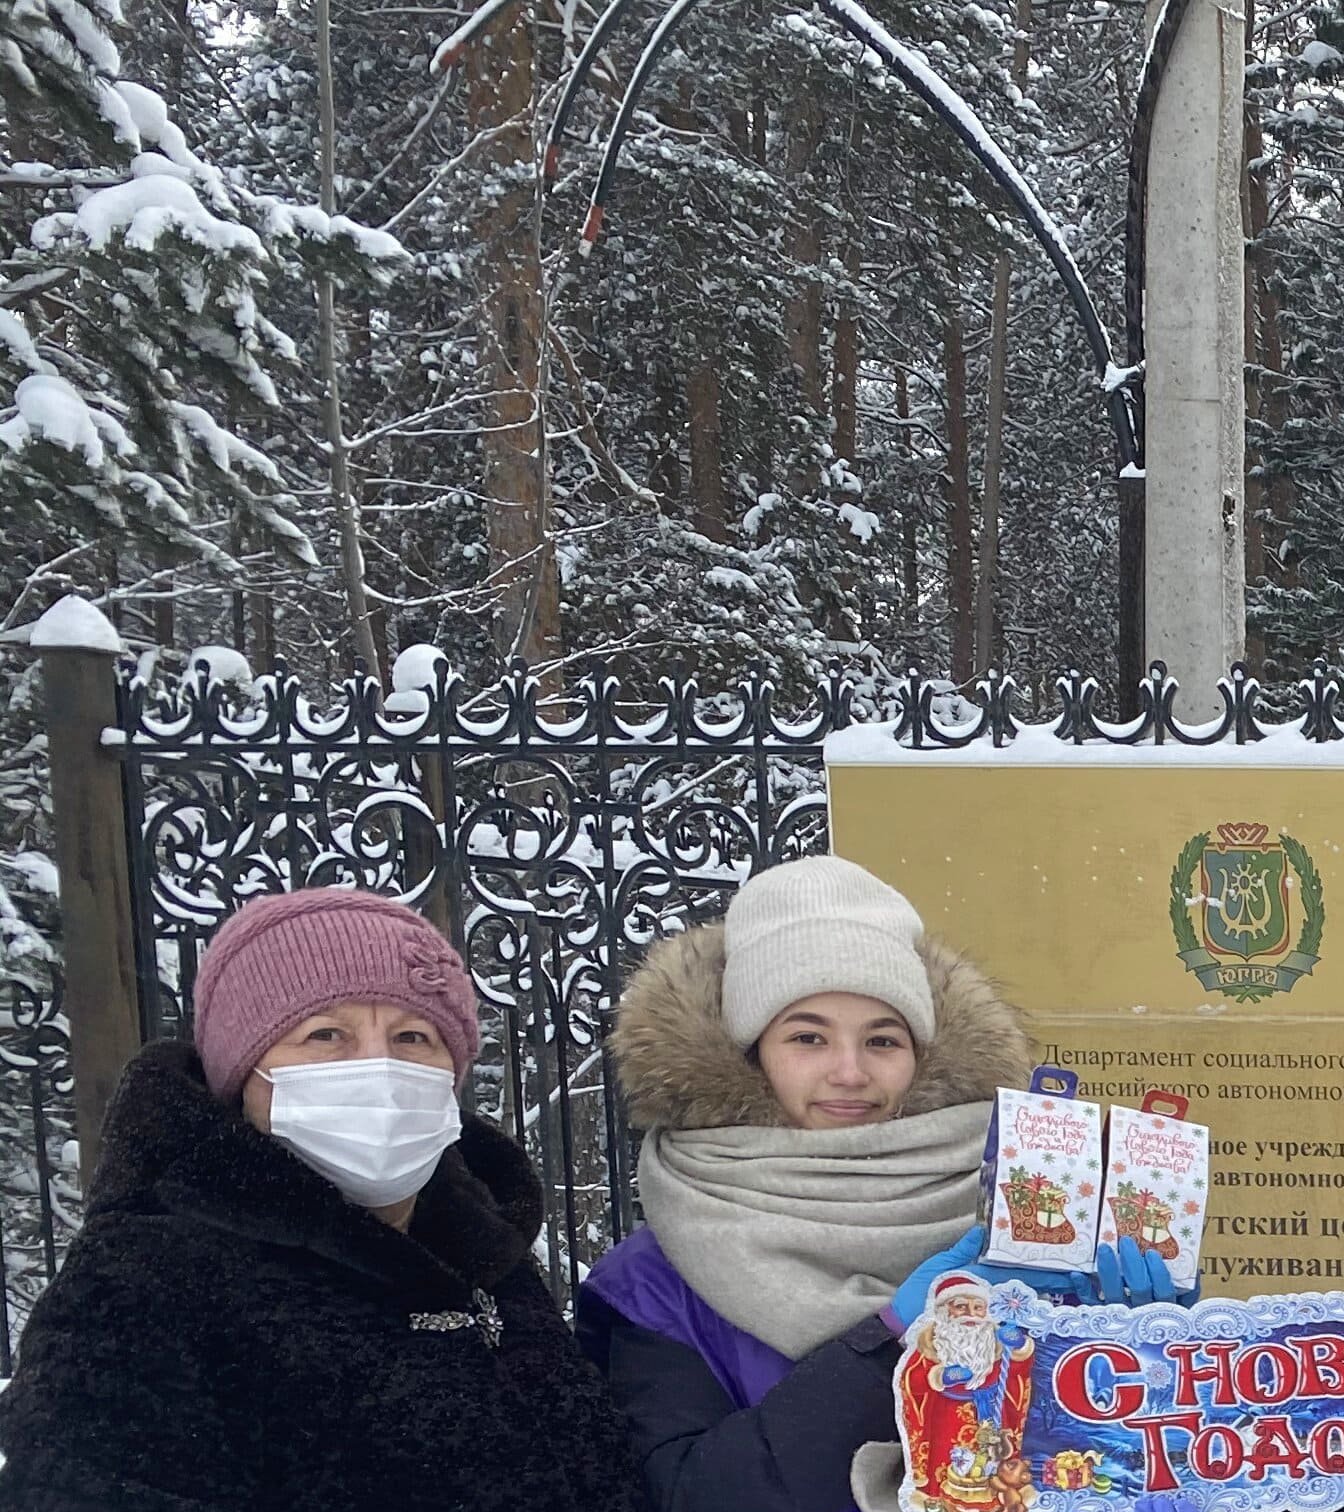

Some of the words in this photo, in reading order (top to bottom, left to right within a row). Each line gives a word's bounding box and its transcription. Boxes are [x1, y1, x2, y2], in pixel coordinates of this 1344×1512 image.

[1042, 1044, 1196, 1071] Департамент
[1208, 1139, 1248, 1156] ное
[1054, 1342, 1147, 1421] С
